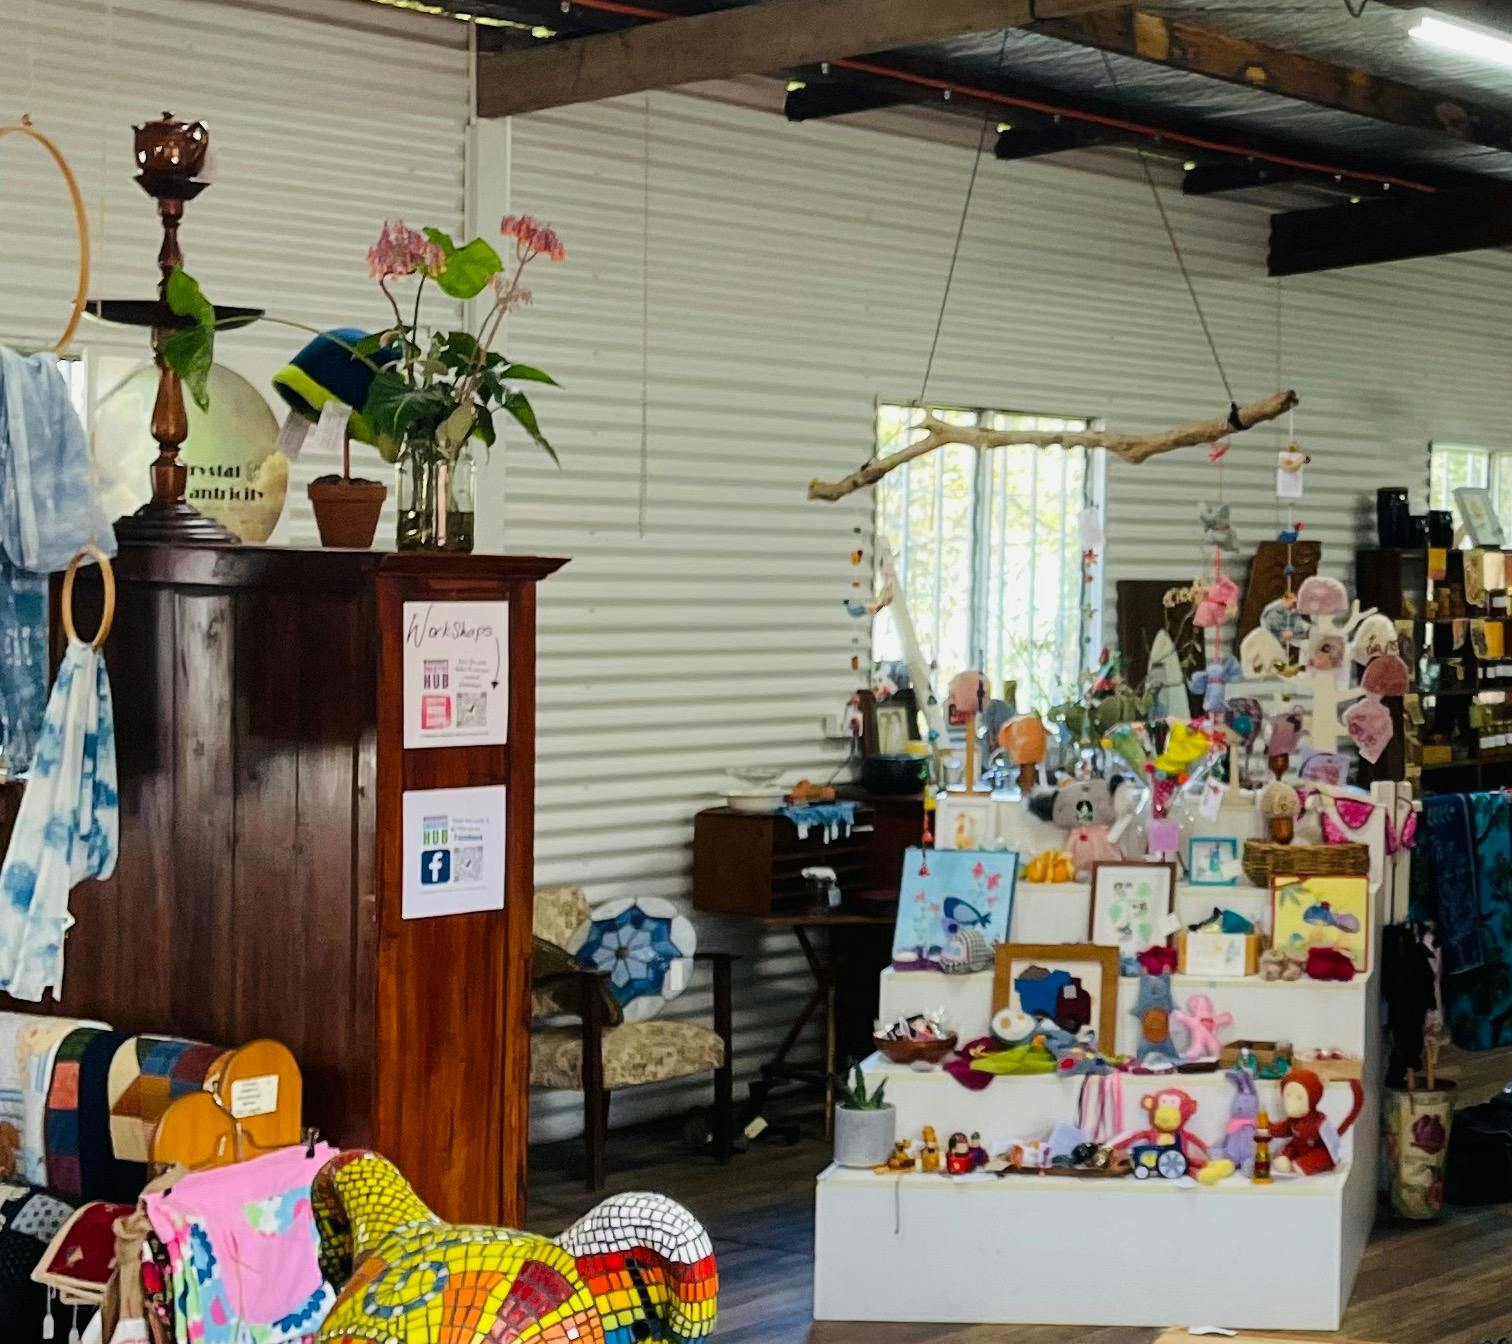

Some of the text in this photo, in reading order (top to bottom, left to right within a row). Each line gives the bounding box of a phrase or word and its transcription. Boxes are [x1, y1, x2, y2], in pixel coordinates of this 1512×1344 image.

[190, 465, 240, 478] rystal
[189, 487, 264, 501] antricity
[423, 674, 449, 690] HUB
[423, 829, 449, 846] HUB
